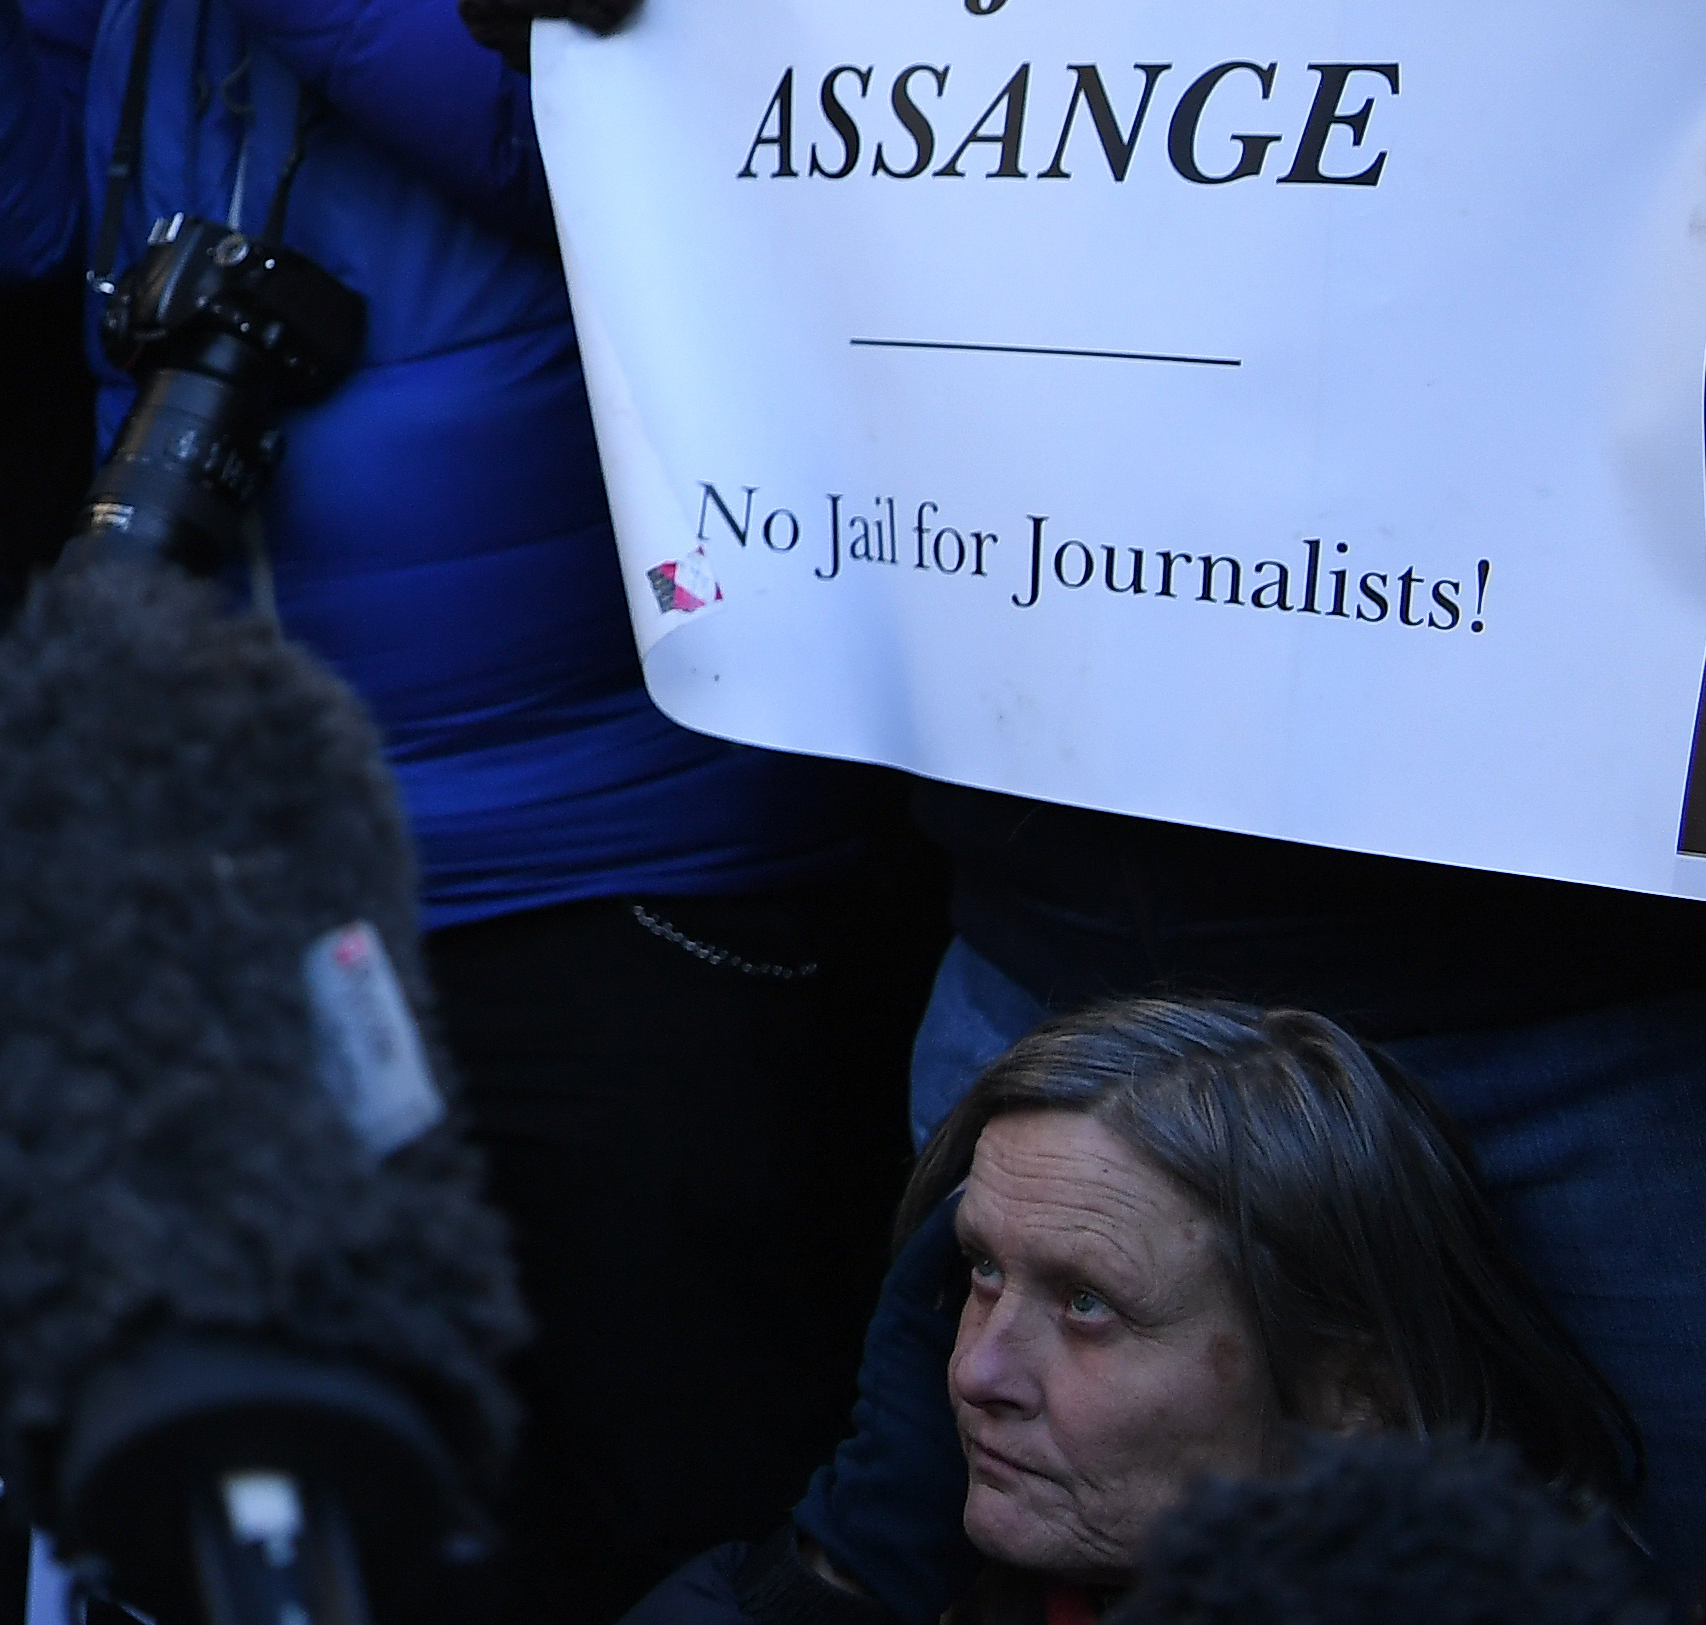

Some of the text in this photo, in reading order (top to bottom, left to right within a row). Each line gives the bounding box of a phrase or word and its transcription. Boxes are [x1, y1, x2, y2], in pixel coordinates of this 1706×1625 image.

[737, 57, 1401, 189] ASSANGE
[696, 480, 1493, 636] No Jail for Journalists!
